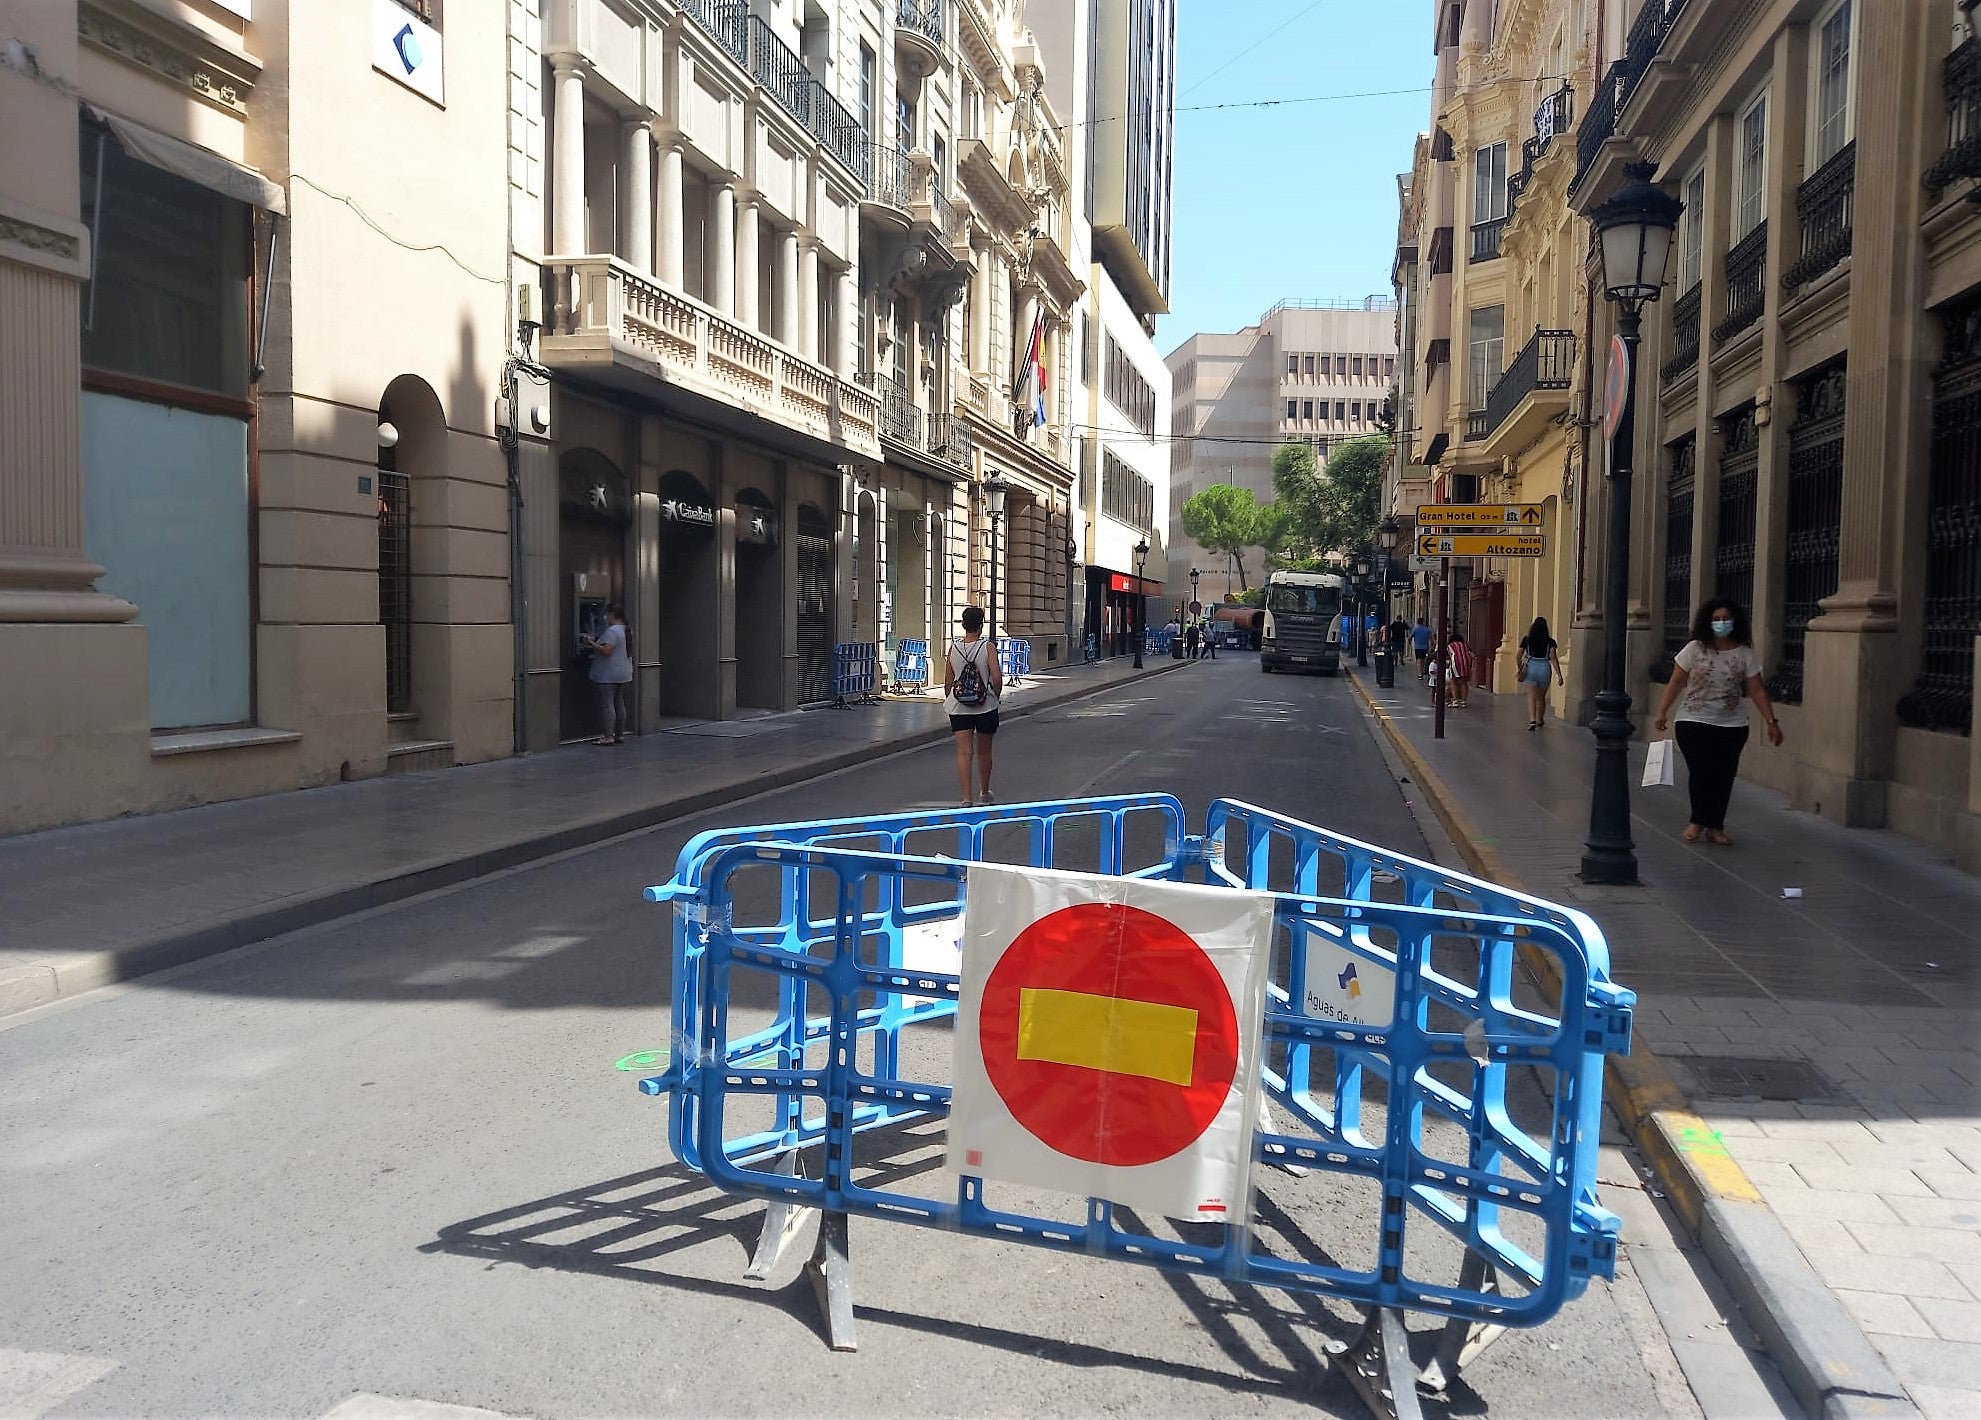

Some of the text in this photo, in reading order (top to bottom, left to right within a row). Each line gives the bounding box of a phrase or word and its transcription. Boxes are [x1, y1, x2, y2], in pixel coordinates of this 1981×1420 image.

[1420, 512, 1443, 521] Gran
[1446, 512, 1475, 521] Hotel
[1486, 545, 1541, 555] Altozano
[1307, 990, 1349, 1023] Aguas de
